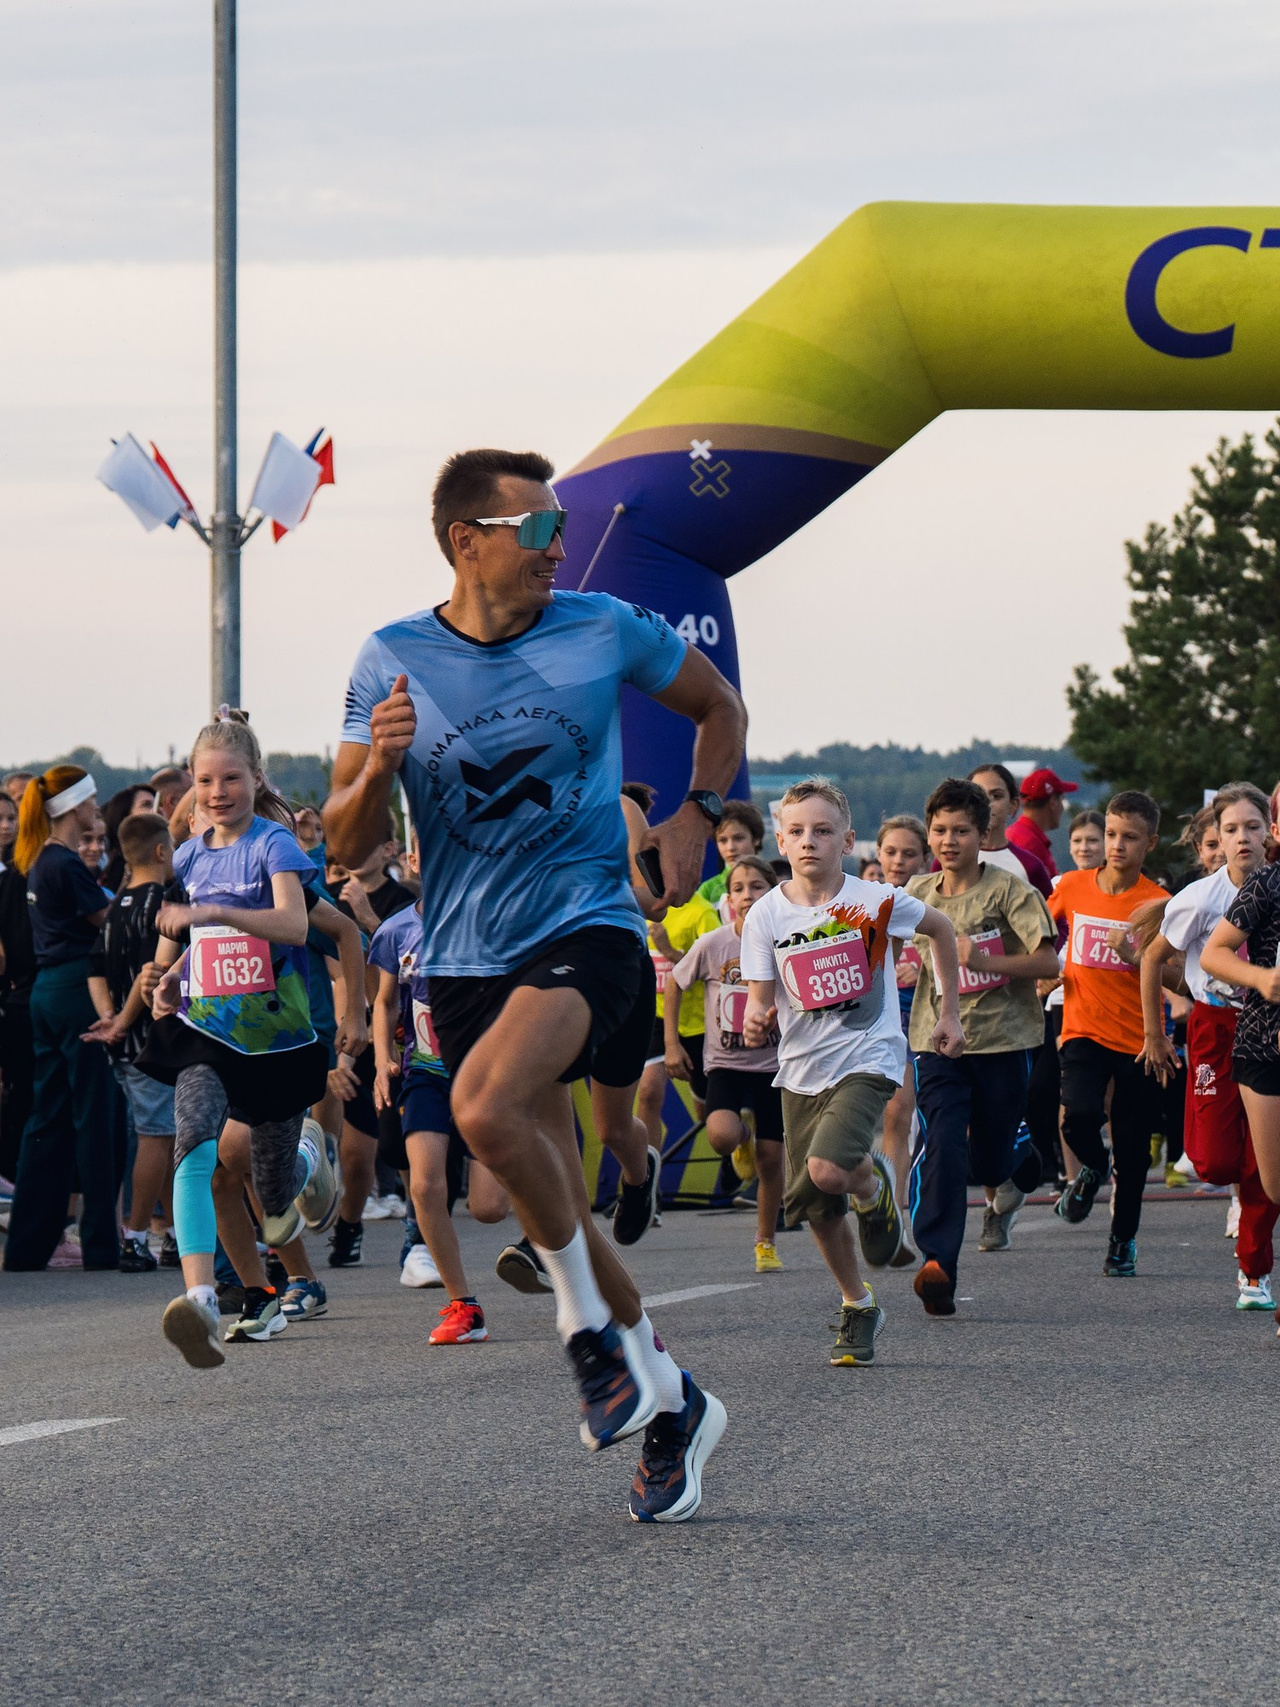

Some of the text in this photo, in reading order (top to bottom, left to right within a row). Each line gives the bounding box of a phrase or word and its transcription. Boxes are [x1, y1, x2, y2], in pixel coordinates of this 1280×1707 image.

[675, 613, 720, 647] 40
[217, 941, 249, 955] МАРИЯ
[812, 951, 850, 971] НИКИТА
[211, 956, 266, 987] 1632
[808, 964, 864, 1002] 3385
